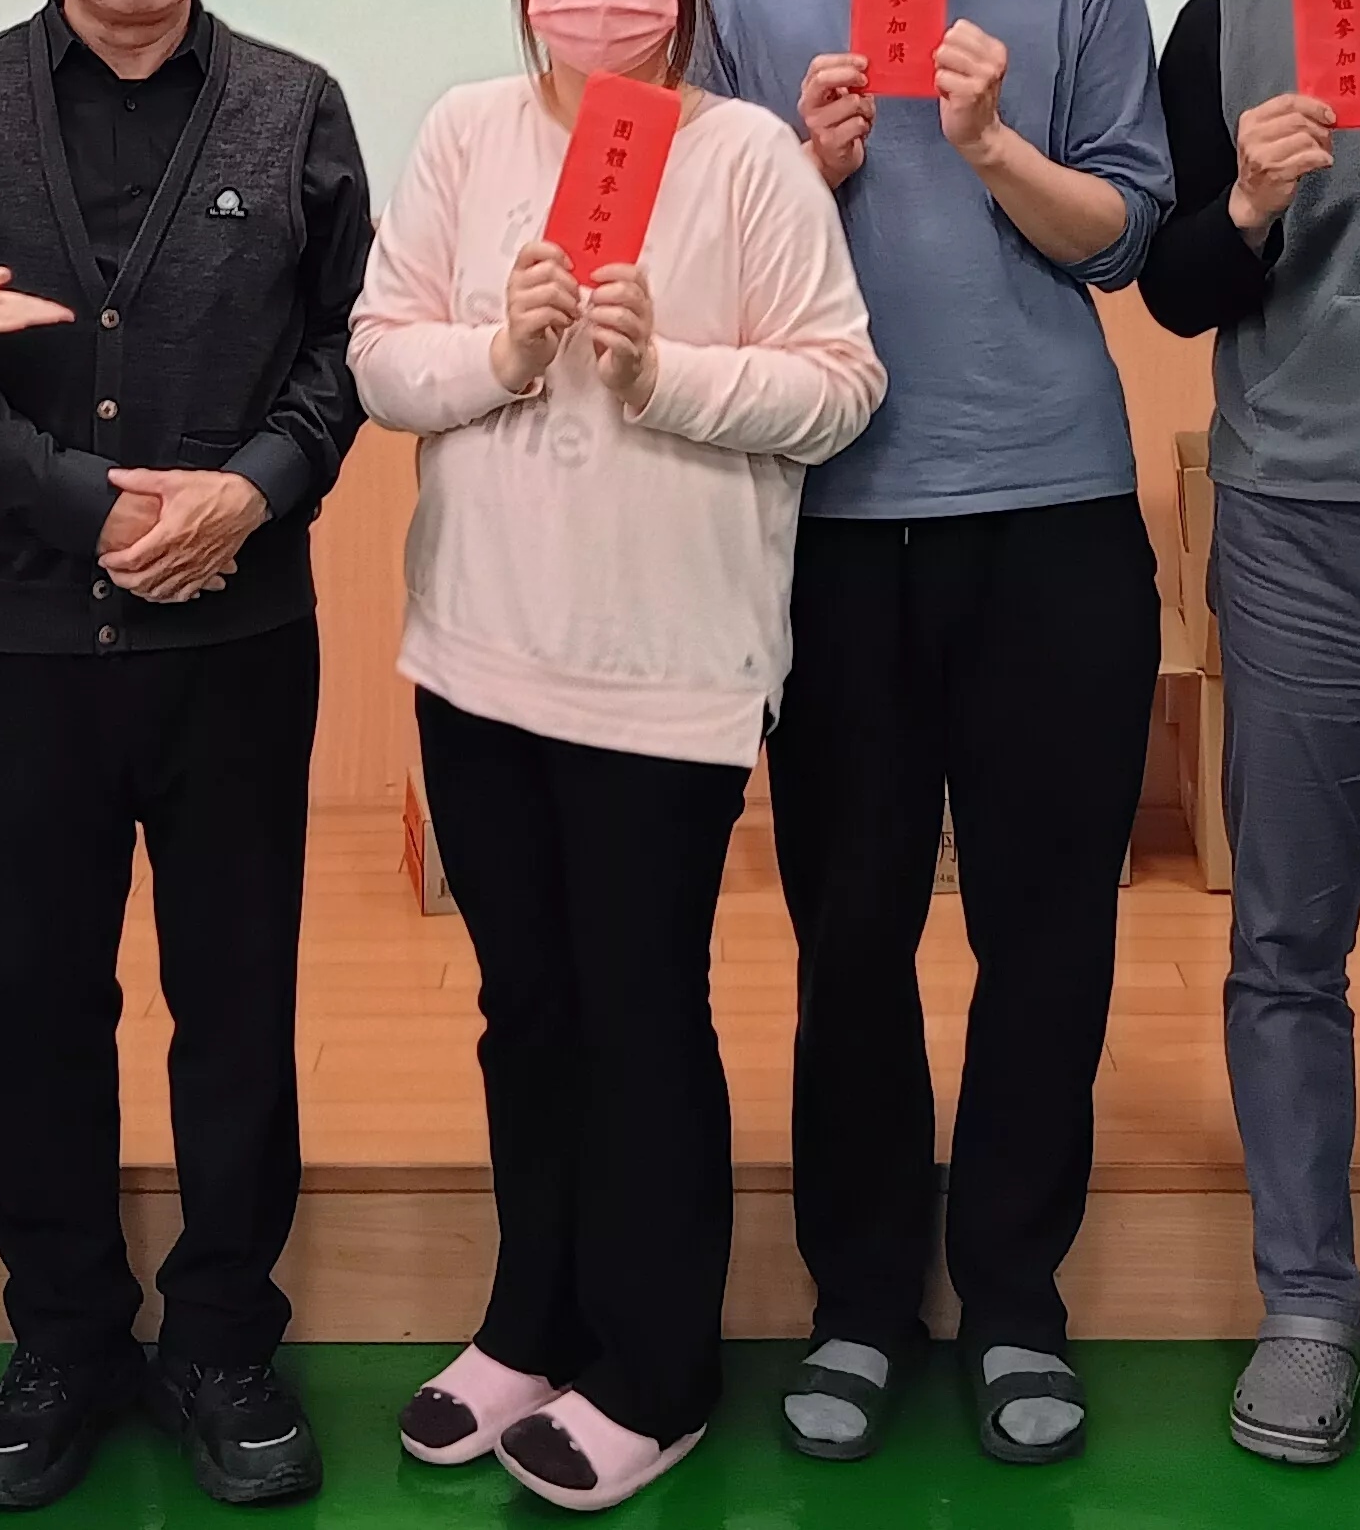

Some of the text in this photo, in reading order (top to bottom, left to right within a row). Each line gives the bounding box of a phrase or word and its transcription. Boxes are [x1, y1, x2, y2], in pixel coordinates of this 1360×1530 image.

[583, 118, 634, 255] 團體參加獎
